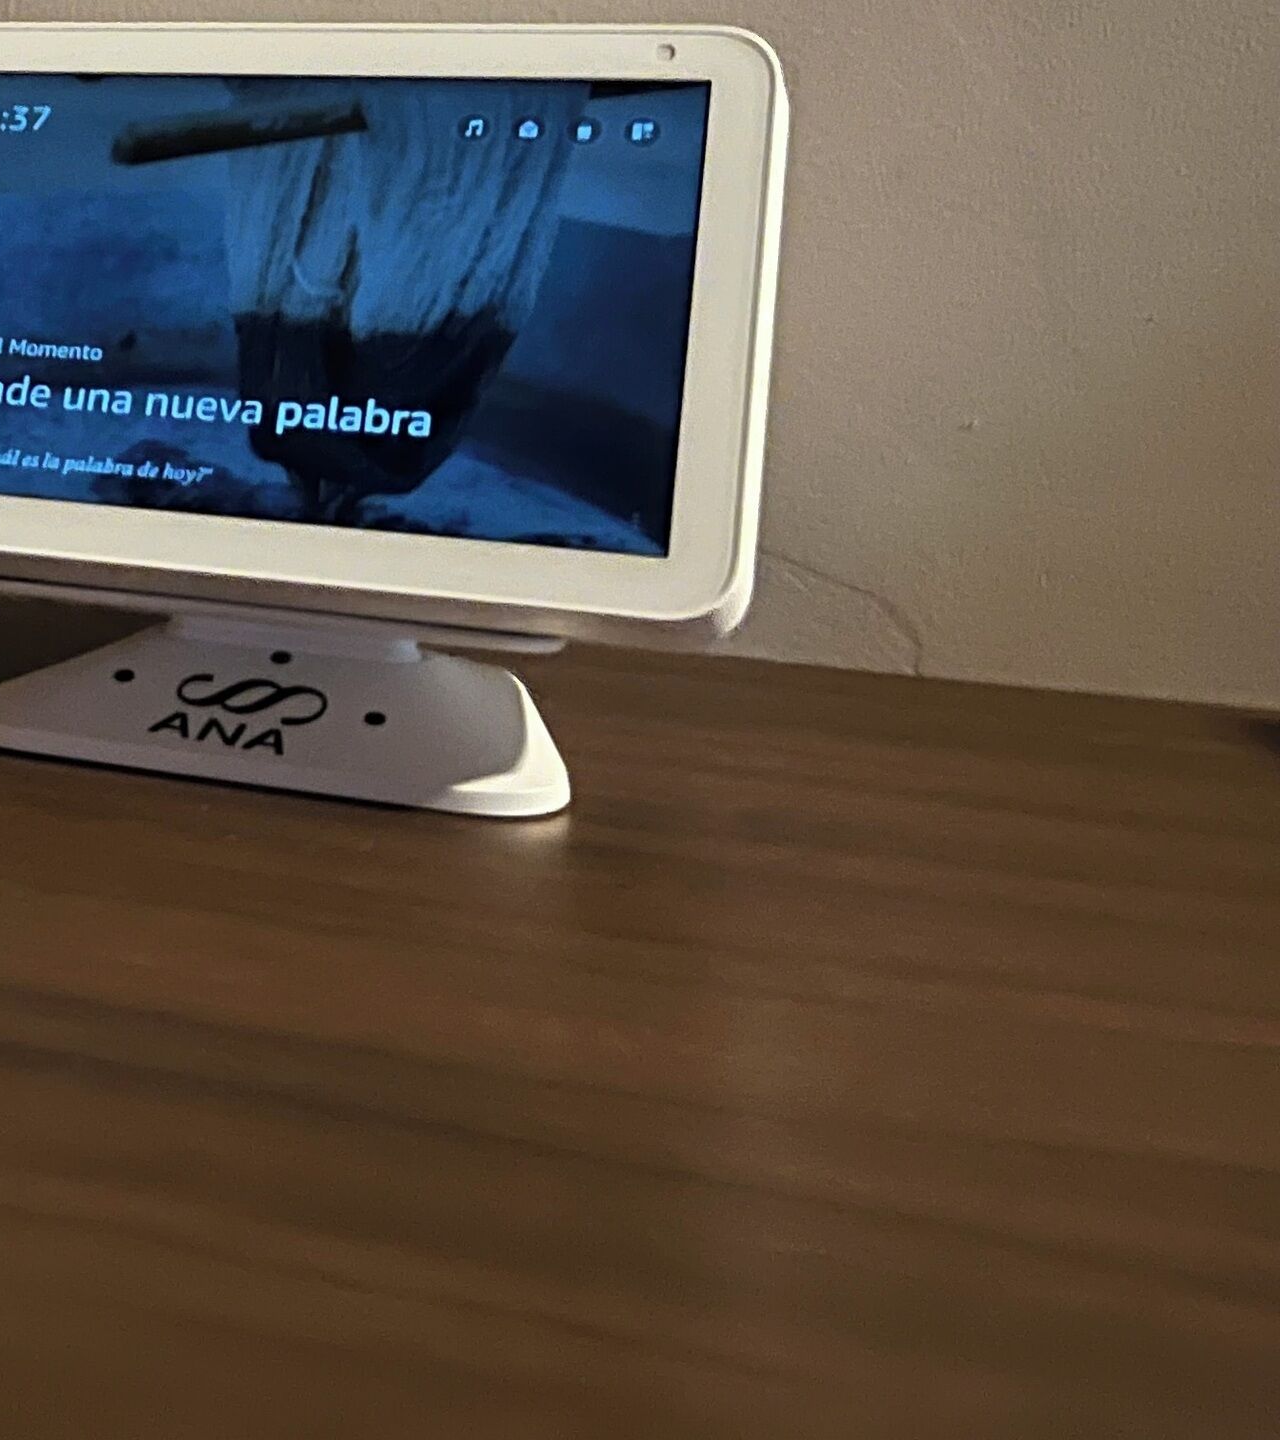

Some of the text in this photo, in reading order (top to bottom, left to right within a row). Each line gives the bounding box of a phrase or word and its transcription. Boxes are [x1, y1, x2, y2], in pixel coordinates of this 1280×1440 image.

[9, 338, 103, 362] Momento
[63, 386, 131, 416] una
[145, 392, 263, 425] nueva
[275, 396, 432, 438] palabra
[21, 453, 40, 468] es
[42, 451, 60, 470] la
[62, 456, 134, 477] palabra
[137, 460, 160, 478] de
[148, 711, 285, 756] ANA
